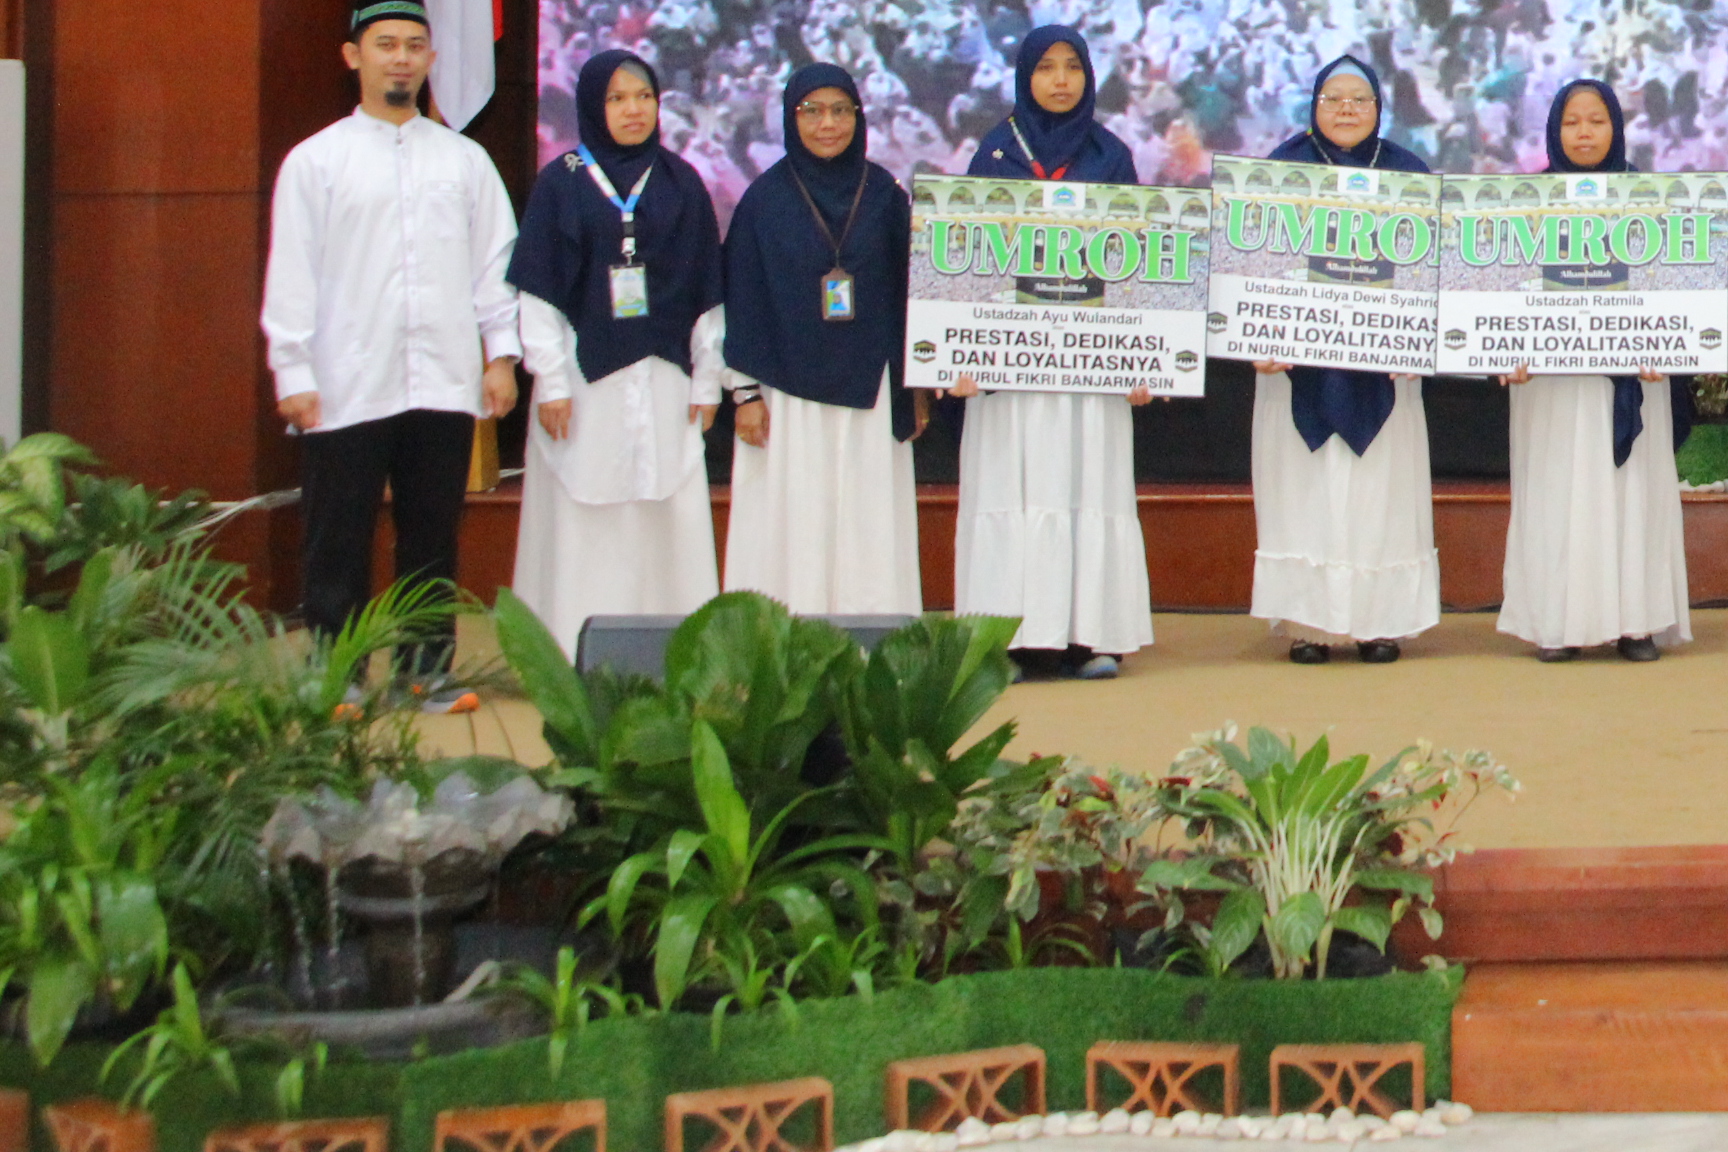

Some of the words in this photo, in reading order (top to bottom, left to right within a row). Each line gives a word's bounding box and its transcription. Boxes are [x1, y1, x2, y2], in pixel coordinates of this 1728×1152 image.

[1456, 212, 1716, 266] UMROH
[926, 219, 1197, 283] UMROH
[1244, 281, 1308, 296] Ustadzah
[1312, 287, 1348, 302] Lidya
[1353, 291, 1386, 304] Dewi
[1526, 296, 1588, 306] Ustadzah
[1593, 294, 1644, 306] Ratmila
[973, 307, 1038, 320] Ustadzah
[1042, 310, 1068, 324] Ayu
[1072, 311, 1142, 325] Wulandari
[1236, 301, 1344, 327] PRESTASI,
[1475, 316, 1582, 334] PRESTASI,
[1590, 315, 1694, 333] DEDIKASI,
[945, 328, 1055, 350] PRESTASI,
[1064, 332, 1170, 354] DEDIKASI,
[1242, 322, 1286, 340] DAN
[1294, 326, 1436, 353] LOYALITASNY
[1482, 336, 1524, 351] DAN
[1533, 336, 1686, 351] LOYALITASNYA
[952, 350, 996, 366] DAN
[1004, 351, 1162, 372] LOYALITASNYA
[1228, 341, 1242, 352] DI
[1248, 342, 1300, 358] NURUL
[1304, 348, 1343, 362] FIKRI
[1468, 356, 1482, 367] DI
[1488, 356, 1540, 368] NURUL
[1545, 356, 1584, 368] FIKRI
[1589, 355, 1699, 368] BANJARMASIN
[938, 370, 952, 382] DI
[1016, 372, 1056, 385] FIKRI
[1061, 374, 1174, 389] BANJARMASIN
